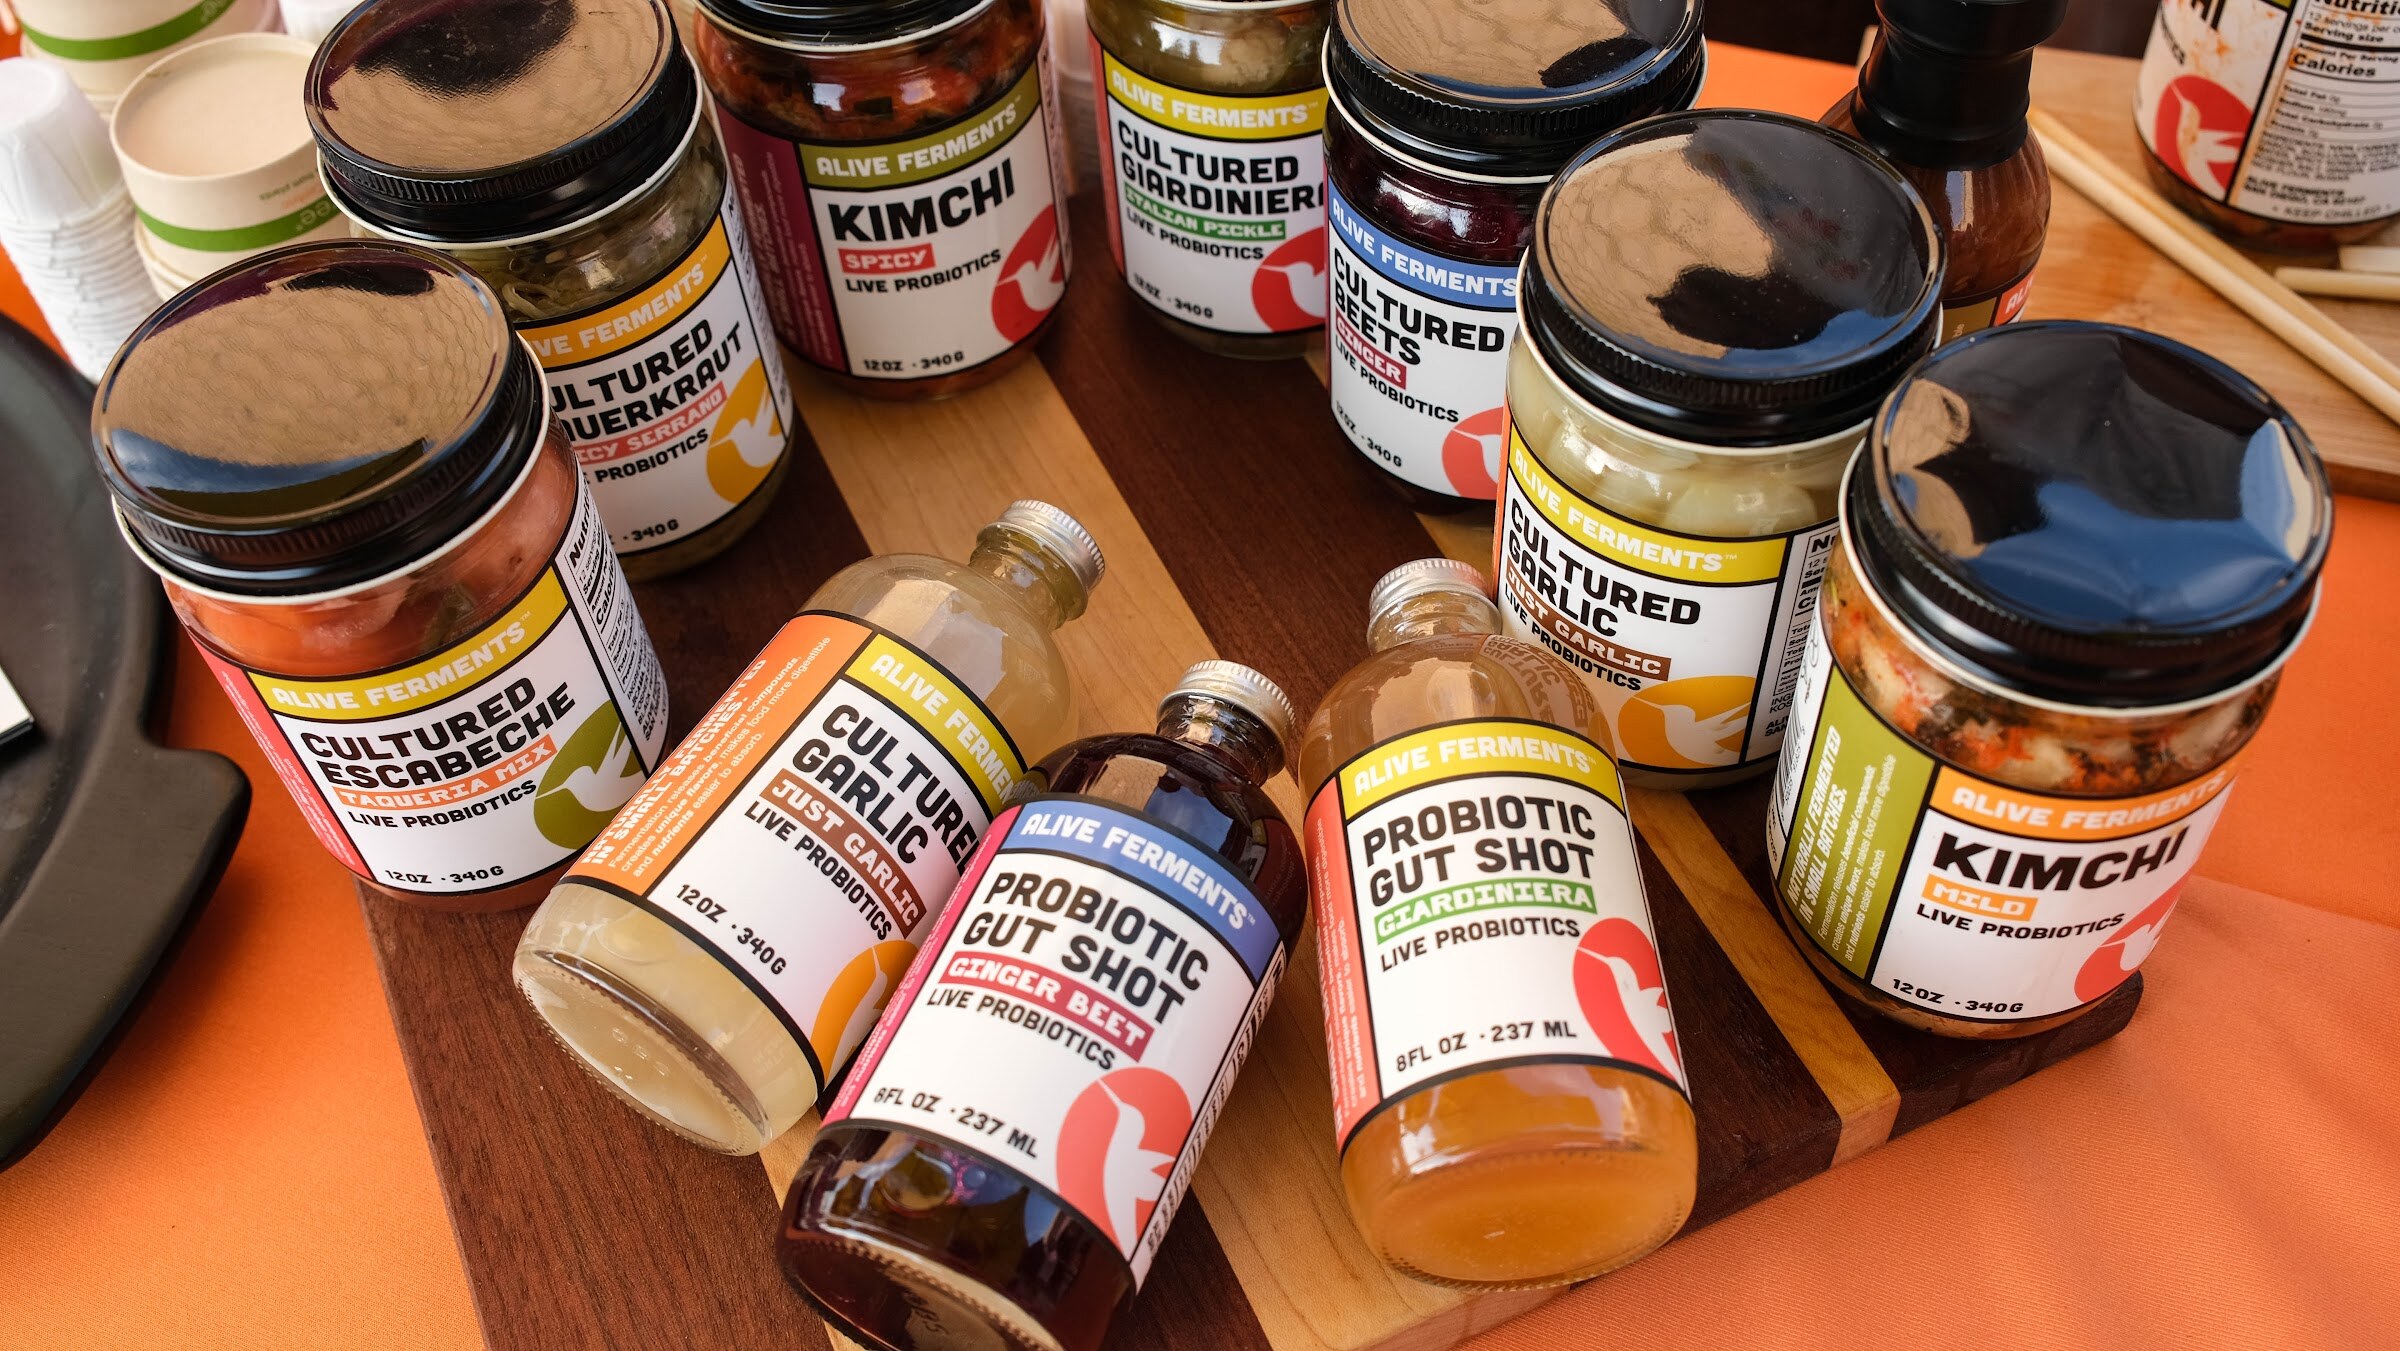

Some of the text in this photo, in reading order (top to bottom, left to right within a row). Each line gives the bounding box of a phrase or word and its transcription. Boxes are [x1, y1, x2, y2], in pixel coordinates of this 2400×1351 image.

[2293, 53, 2376, 77] Calories
[2304, 22, 2384, 43] Serving size
[1112, 70, 1164, 114] ALIVE
[816, 156, 890, 177] ALIVE
[1118, 120, 1298, 184] CULTURED
[828, 158, 1015, 242] KIMCHI
[1125, 186, 1284, 238] ITALIAN PICKLE
[1127, 207, 1264, 260] LIVE PROBIOTICS
[1332, 199, 1374, 256] ALIVE
[846, 249, 1001, 294] LIVE PROBIOTICS
[847, 248, 927, 270] SPICY
[1334, 248, 1504, 352] CULTURED
[1334, 279, 1421, 365] BEETS
[550, 319, 712, 412] ULTURED
[1335, 336, 1459, 423] LIVE PROBIOTICS
[1336, 317, 1401, 383] GINGER
[595, 428, 708, 483] PROBIOTICS
[627, 389, 723, 451] SERRANO
[1515, 449, 1561, 513] ALIVE
[1509, 530, 1618, 637] GARLIC
[1511, 498, 1701, 625] CULTURED
[1504, 582, 1641, 691] LIVE PROBIOTICS
[1507, 565, 1662, 675] JUST GARLIC
[274, 687, 359, 710] ALIVE
[300, 677, 537, 762] CULTURED
[870, 653, 953, 716] ALIVE
[317, 681, 577, 788] ESCABECHE
[582, 658, 764, 864] NATURALLY FERMENTED
[609, 653, 801, 867] Fermentation releases beneficial compounds,
[621, 635, 831, 871] creates unique flavors, makes food more digestible
[339, 744, 552, 811] TAQUERIA MIX
[348, 780, 537, 828] LIVE PROBIOTICS
[593, 693, 747, 864] IN SMALL BATCHES.
[632, 728, 765, 877] and nutrients easier to absorb.
[792, 738, 929, 864] GARLIC
[1354, 746, 1428, 796] ALIVE
[1952, 786, 2050, 827] ALIVE
[1021, 812, 1095, 844] ALIVE
[1362, 795, 1595, 867] PROBIOTIC
[1787, 725, 1842, 904] NATURALLY FERMENTED
[1818, 763, 1876, 938] Fermentation releases beneficial compounds.
[744, 800, 892, 940] LIVE PROBIOTICS
[771, 777, 921, 928] JUST GARLIC
[1369, 838, 1596, 907] GUT SHOT
[1799, 784, 1846, 923] IN SMALL BATCHES.
[1830, 752, 1897, 950] creates unique flavors, makes food more digestible
[1932, 825, 2190, 892] KIMCHI
[983, 871, 1209, 991] PROBIOTIC
[1378, 882, 1594, 938] GIARDINIERA
[1843, 846, 1885, 961] and nutrients easier to absorb.
[1916, 903, 2126, 941] LIVE PROBIOTICS
[1931, 881, 2027, 916] MILD
[963, 912, 1185, 1027] GUT SHOT
[1380, 917, 1580, 973] LIVE PROBIOTICS
[926, 988, 1116, 1071] LIVE PROBIOTICS
[948, 957, 1147, 1049] GINGER BEET
[1396, 1047, 1431, 1072] 8FL
[1439, 1031, 1468, 1056] OZ
[1544, 1020, 1577, 1040] ML
[873, 1086, 904, 1106] 8FL
[910, 1093, 941, 1111] OZ
[1006, 1130, 1040, 1158] ML
